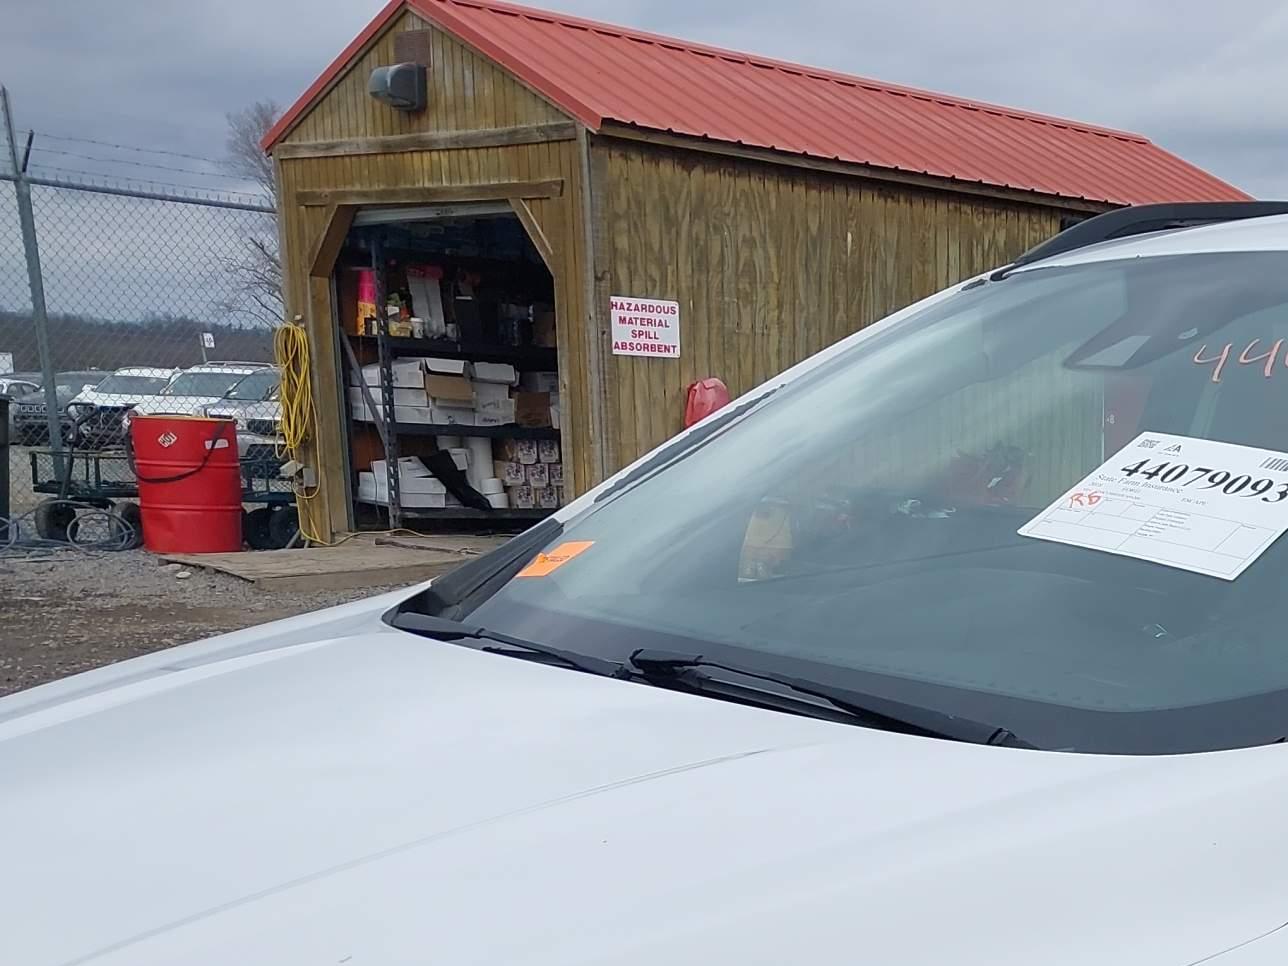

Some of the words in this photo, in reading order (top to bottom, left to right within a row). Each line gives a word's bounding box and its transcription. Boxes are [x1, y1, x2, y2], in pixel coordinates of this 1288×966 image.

[610, 301, 677, 315] HAZARDOUS
[618, 316, 670, 328] MATERIAL
[631, 329, 660, 340] SPILL
[614, 341, 677, 353] ABSORBENT
